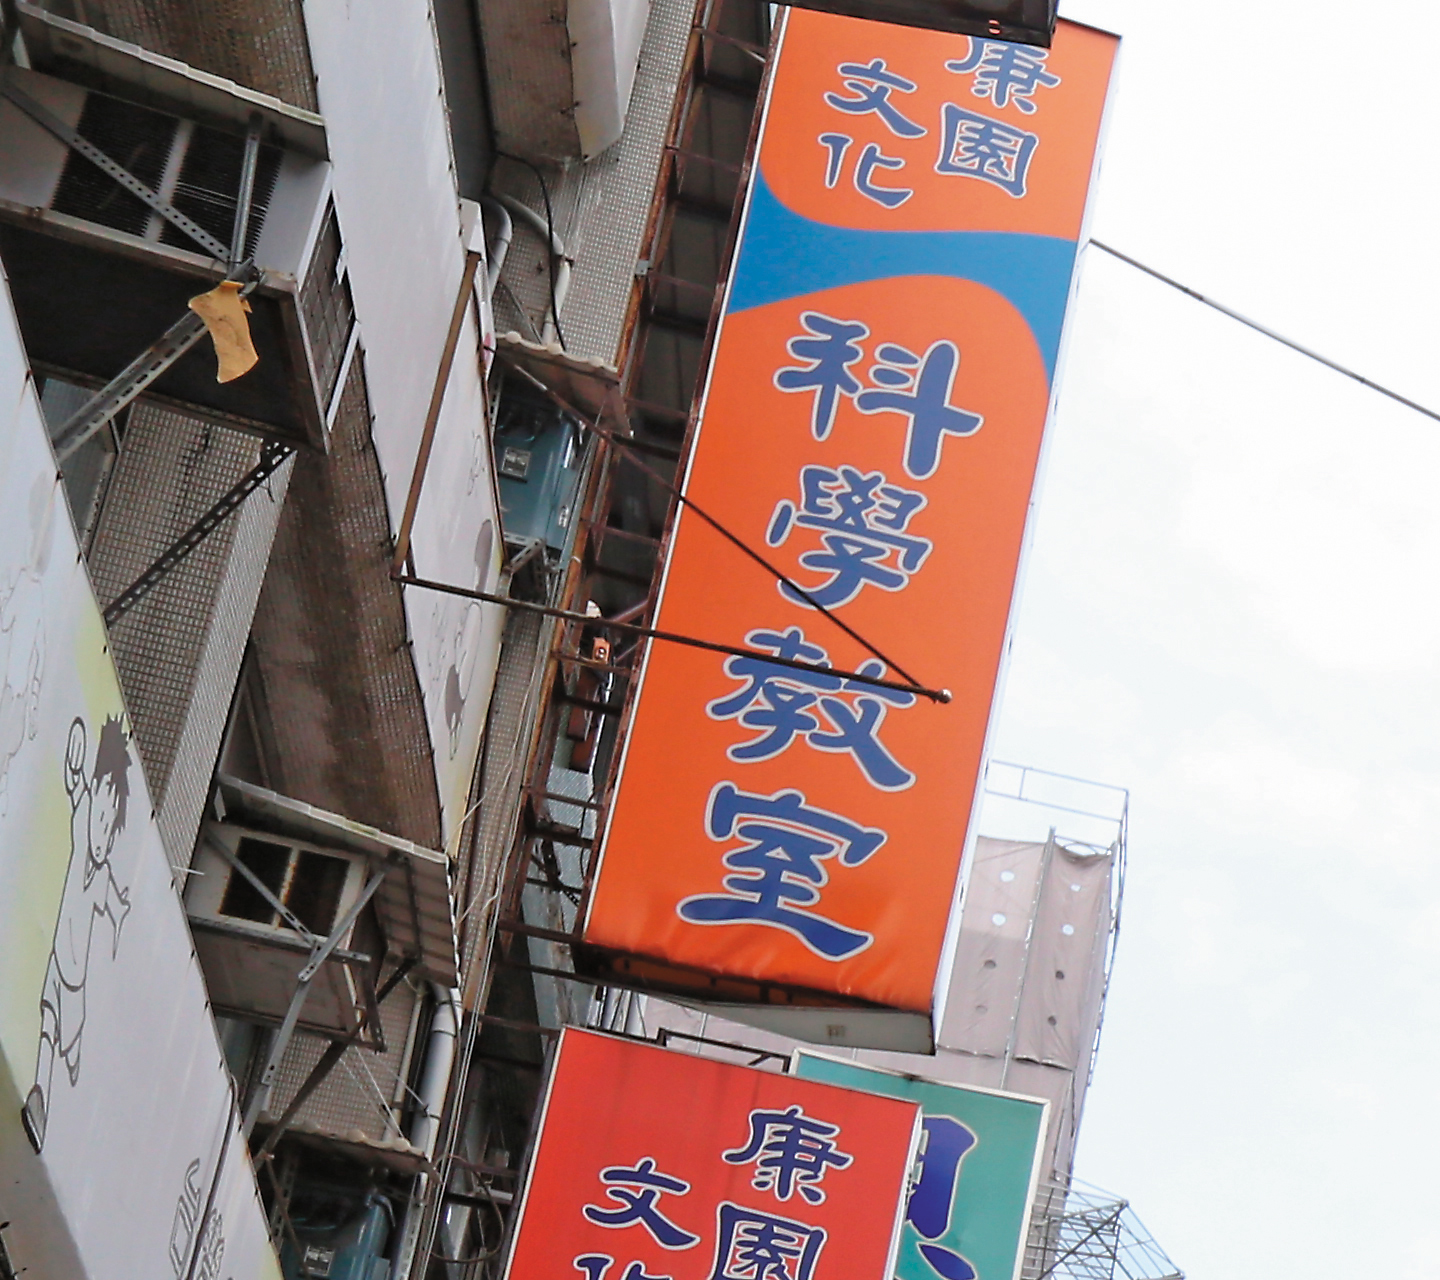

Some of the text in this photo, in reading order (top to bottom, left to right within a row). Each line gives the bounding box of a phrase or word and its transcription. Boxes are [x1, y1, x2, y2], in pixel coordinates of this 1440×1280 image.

[818, 58, 928, 209] 文化
[676, 309, 985, 958] 科學教室
